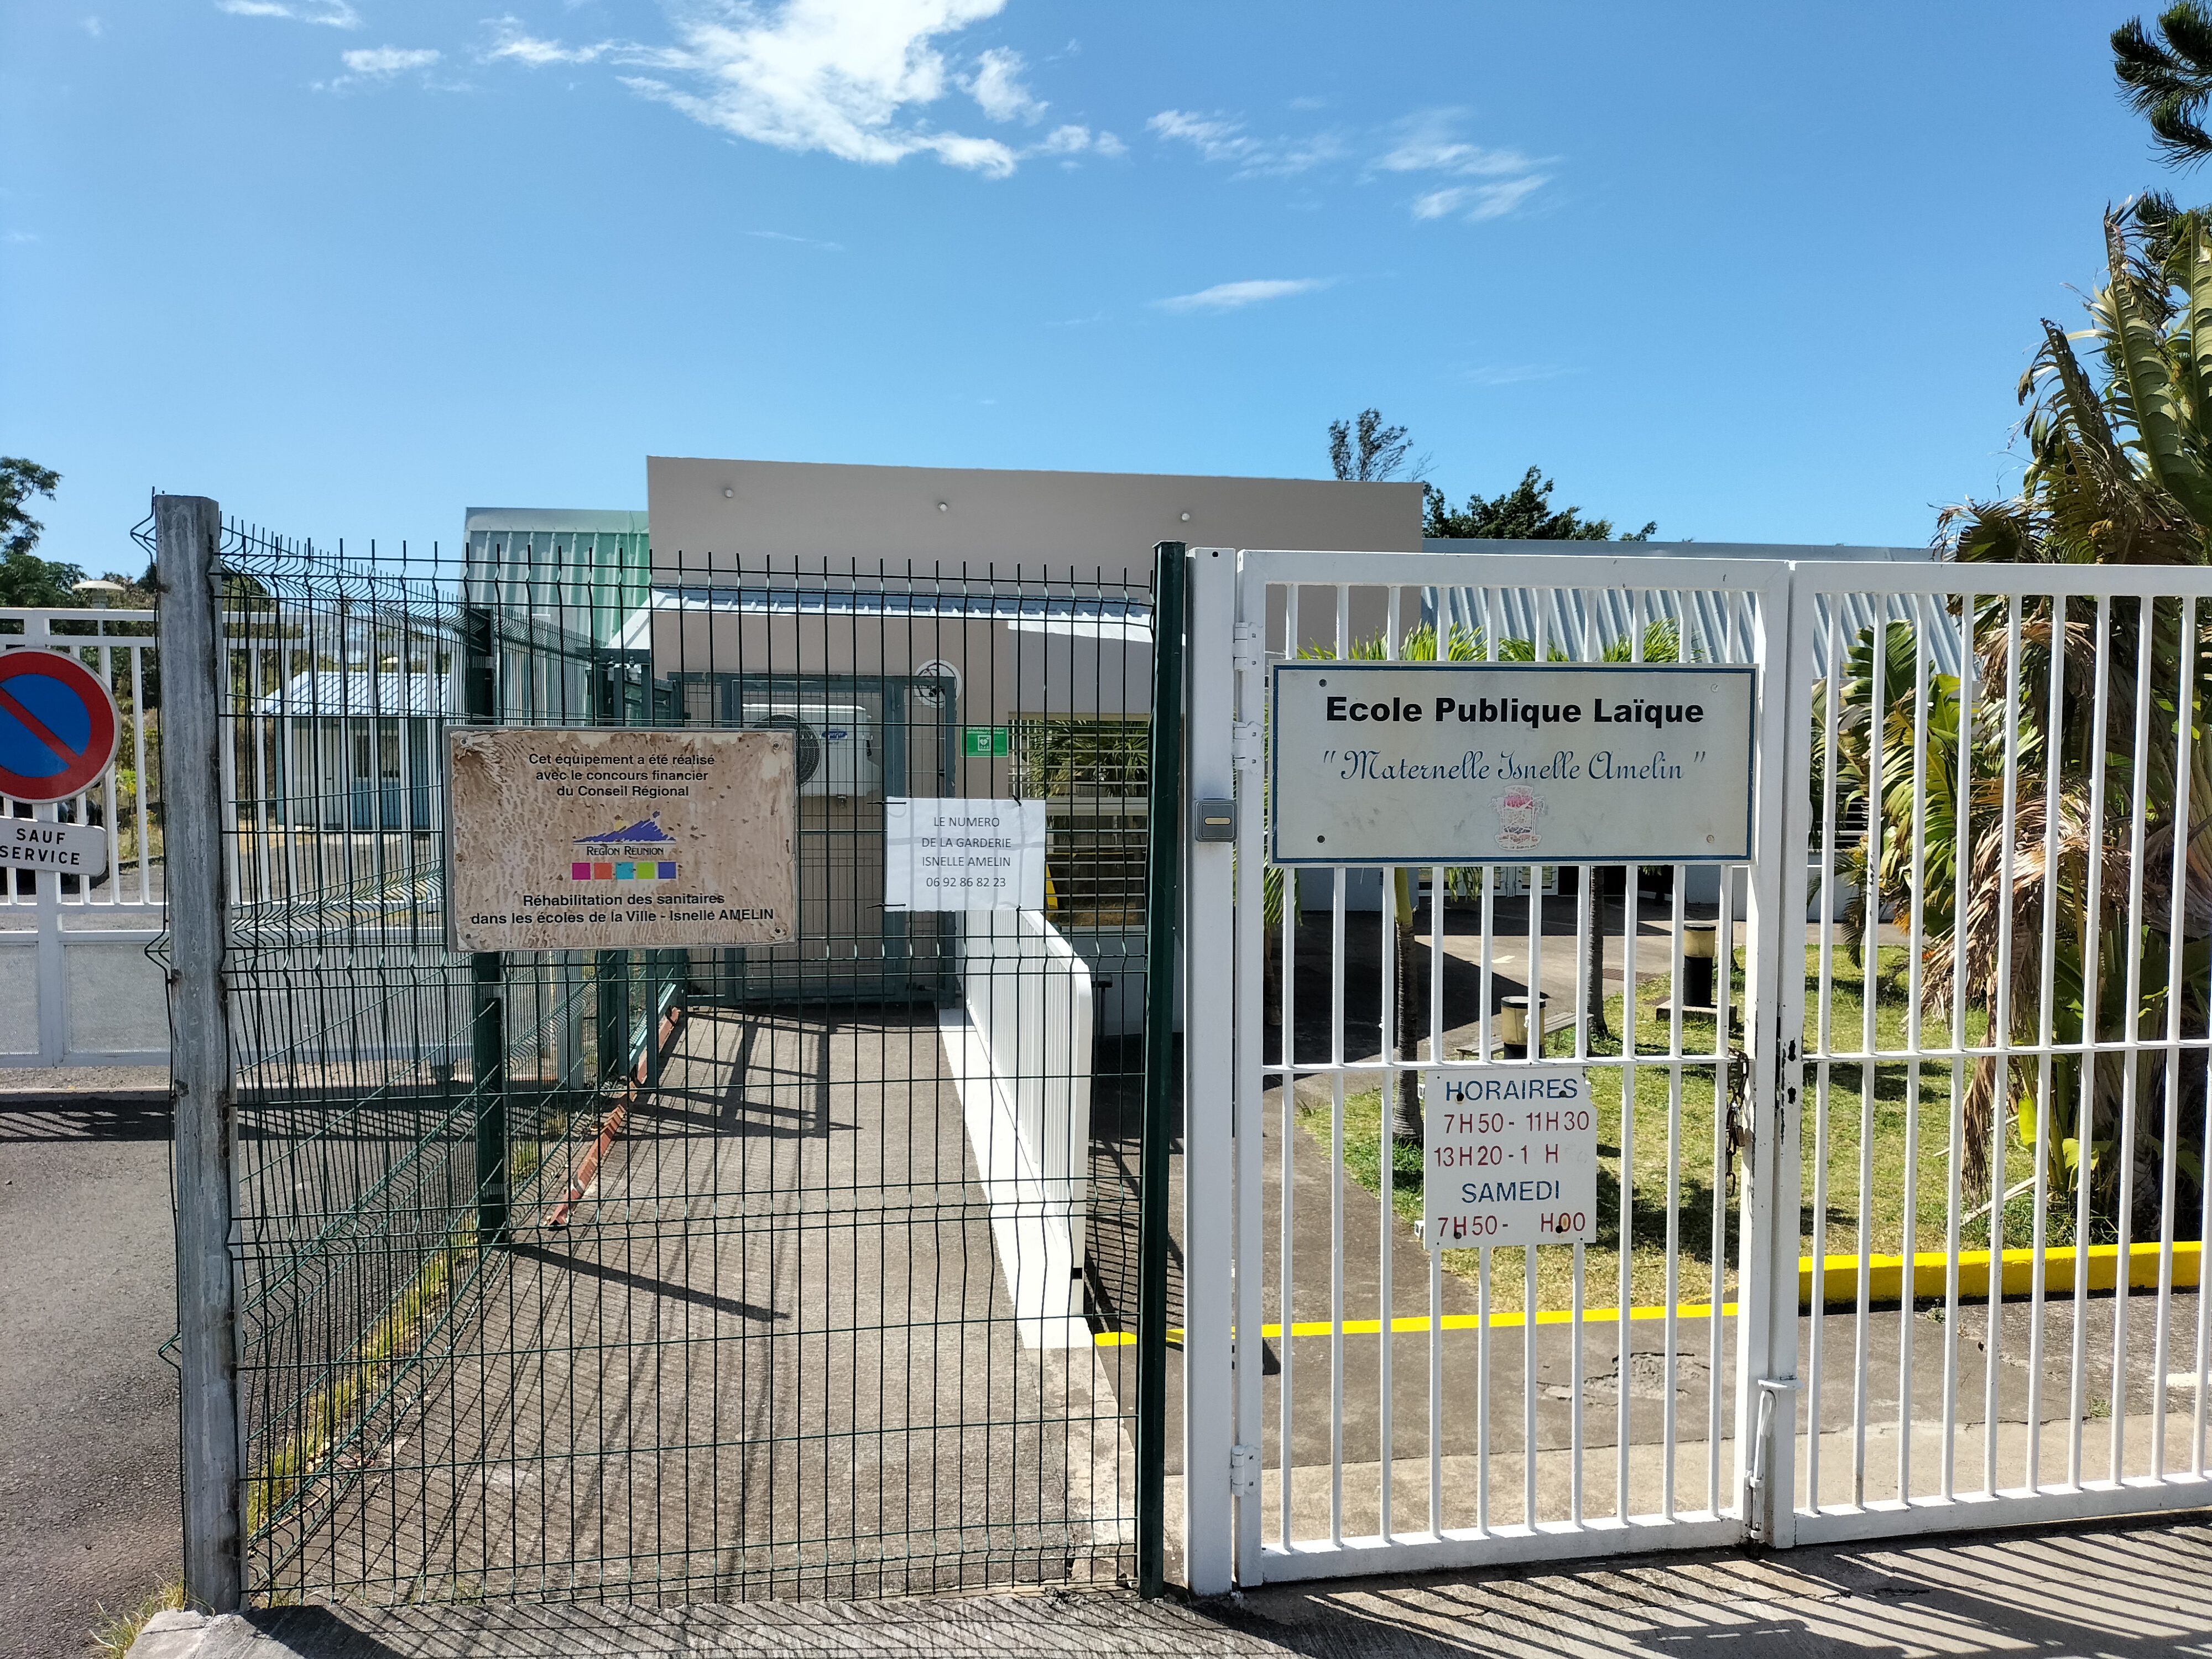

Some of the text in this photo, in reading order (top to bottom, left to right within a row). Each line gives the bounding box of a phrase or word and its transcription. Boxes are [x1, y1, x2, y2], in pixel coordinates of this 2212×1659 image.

[1327, 696, 1704, 729] Ecole Publique Laïque
[529, 753, 715, 767] Cet équipement a été réalisé
[1340, 750, 1491, 780] Maternelle
[1498, 750, 1582, 780] Isnelle
[1588, 750, 1684, 780] Amelin
[536, 770, 708, 781] avec le concours financier
[557, 785, 689, 799] du Conseil Régional
[934, 817, 1000, 827] LE NUMERO
[16, 828, 65, 844] SAUF
[922, 838, 1011, 848] DE LA GARDERIE
[0, 846, 80, 865] SERVICE
[922, 857, 1011, 867] ISNELLE AMELIN
[926, 877, 1006, 887] 06 92 86 82 23
[523, 893, 725, 906] Réhabilitation des sanitaires
[471, 913, 507, 924] dans
[512, 912, 533, 924] les
[537, 911, 584, 924] écoles
[589, 911, 606, 922] de
[611, 911, 623, 922] la
[625, 910, 656, 922] Ville
[670, 910, 715, 921] Isnelle
[719, 909, 774, 920] AMELIN
[1446, 1078, 1578, 1101] HORAIRES
[1462, 1181, 1559, 1203] SAMEDI
